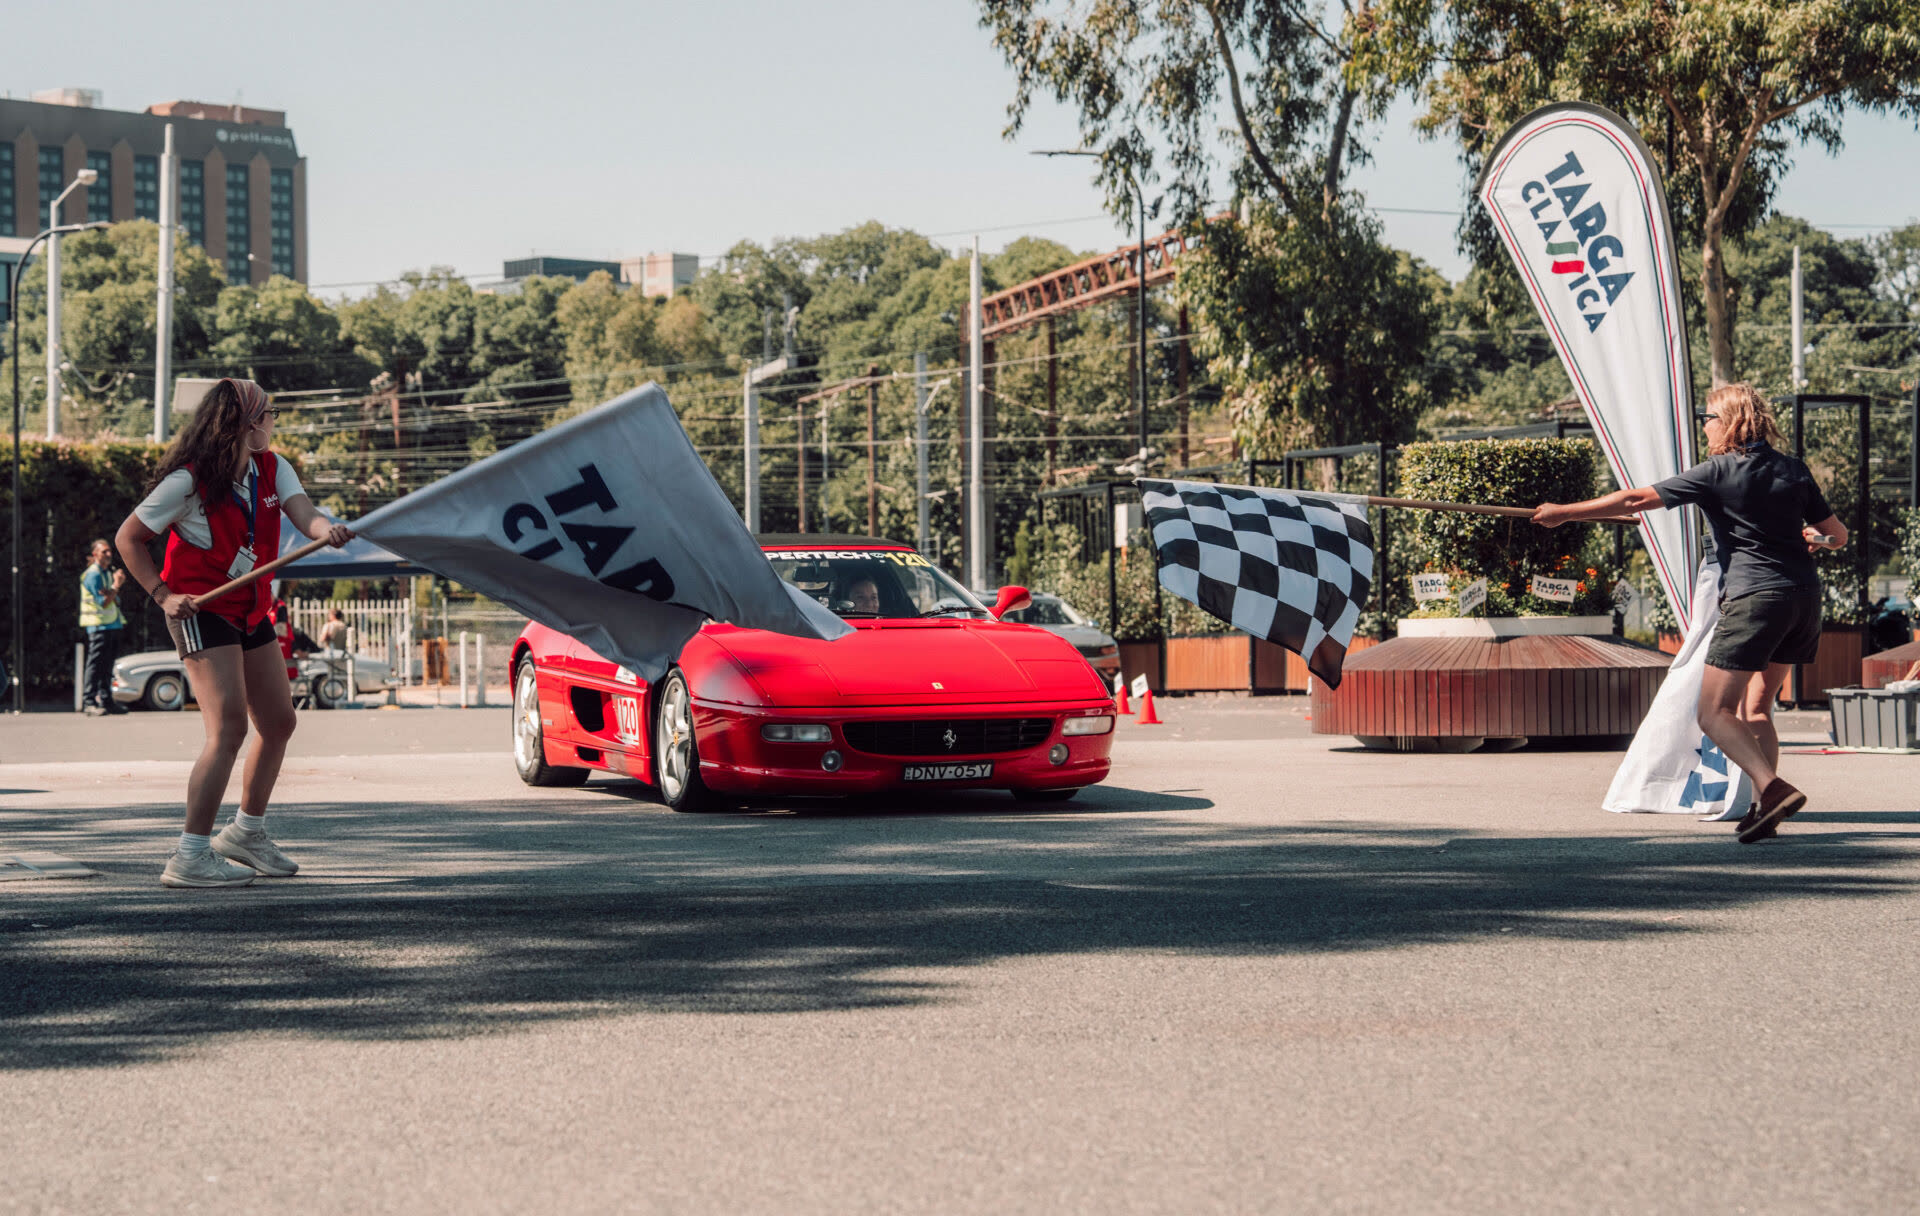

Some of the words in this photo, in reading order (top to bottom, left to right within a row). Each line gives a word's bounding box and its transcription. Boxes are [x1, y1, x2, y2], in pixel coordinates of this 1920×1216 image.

[1545, 151, 1636, 307] TARGA
[764, 551, 871, 560] PERTECH
[885, 552, 931, 567] 120
[1537, 581, 1569, 591] TARGA
[619, 697, 637, 737] 120
